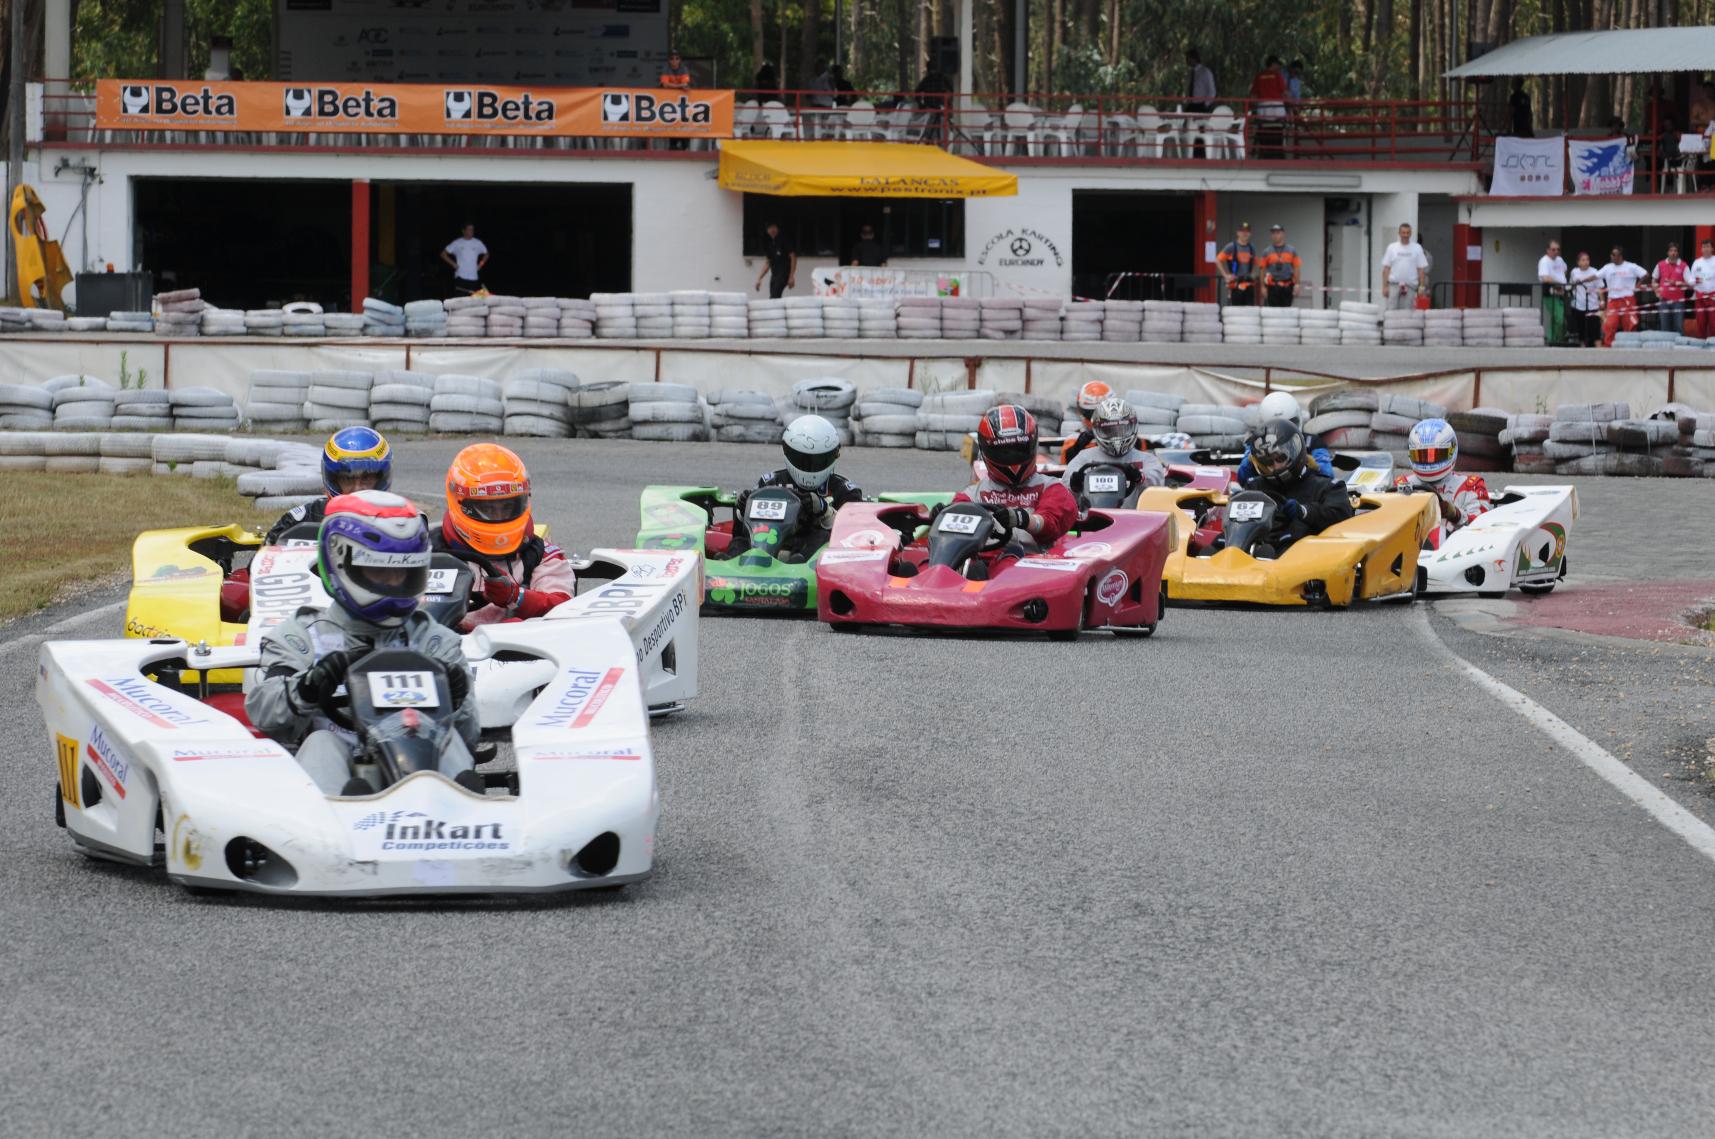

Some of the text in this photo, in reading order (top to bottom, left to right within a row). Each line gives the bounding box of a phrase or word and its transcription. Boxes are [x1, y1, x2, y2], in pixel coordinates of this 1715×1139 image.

[154, 86, 236, 116] Beta
[316, 88, 398, 118] Beta
[476, 91, 556, 121] Beta
[634, 94, 711, 123] Beta
[977, 228, 1064, 267] ESCOLA KARTING
[756, 501, 784, 510] 89
[952, 515, 974, 524] 10
[739, 582, 792, 600] JOGOS
[643, 610, 675, 657] Desportivo
[380, 674, 424, 688] 111
[106, 677, 209, 725] Mucoral
[536, 669, 602, 728] Mucoral
[90, 722, 129, 786] Mucoral
[385, 819, 503, 840] InKart
